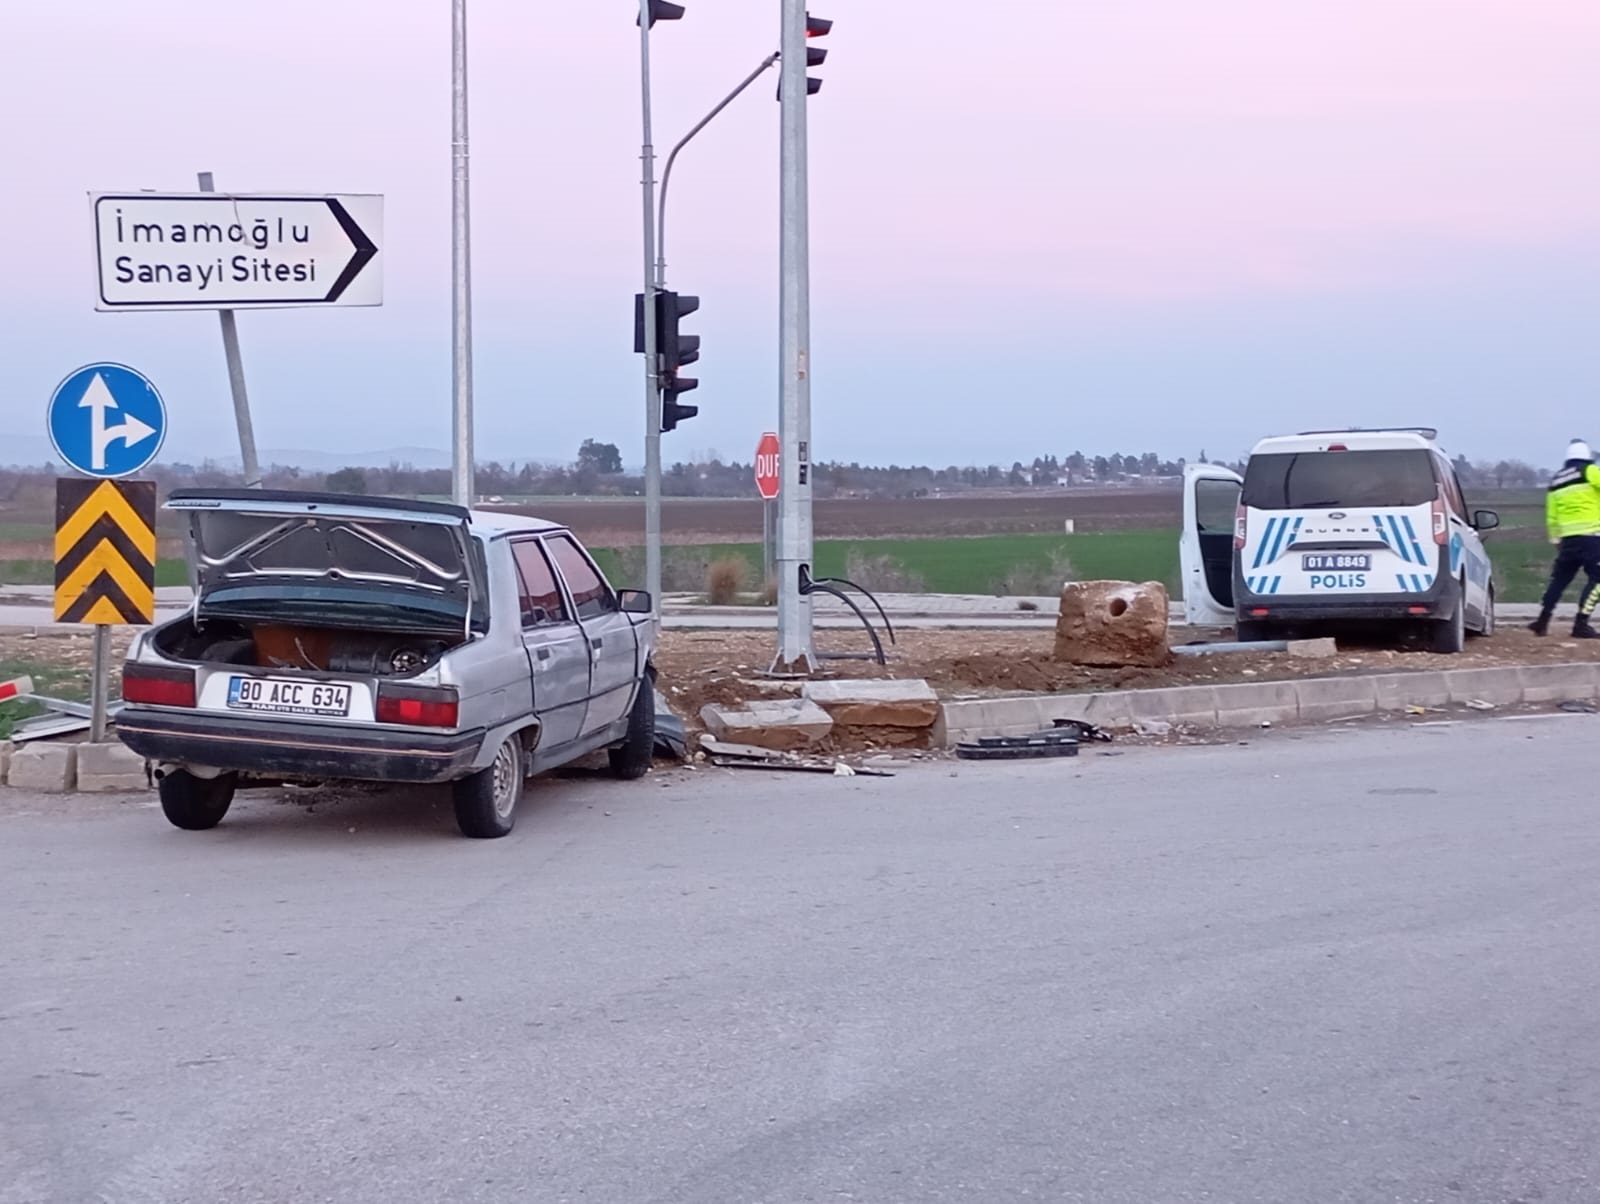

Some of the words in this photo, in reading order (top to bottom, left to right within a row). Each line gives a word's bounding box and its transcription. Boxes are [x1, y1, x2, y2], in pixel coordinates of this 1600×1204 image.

[116, 208, 310, 250] İmamoğlu
[115, 256, 223, 290] Sanayi
[231, 255, 316, 282] Sitesi
[1308, 556, 1322, 568] 01
[1325, 556, 1334, 568] A
[240, 681, 262, 701] 80
[270, 683, 303, 704] ACC
[312, 687, 344, 708] 634
